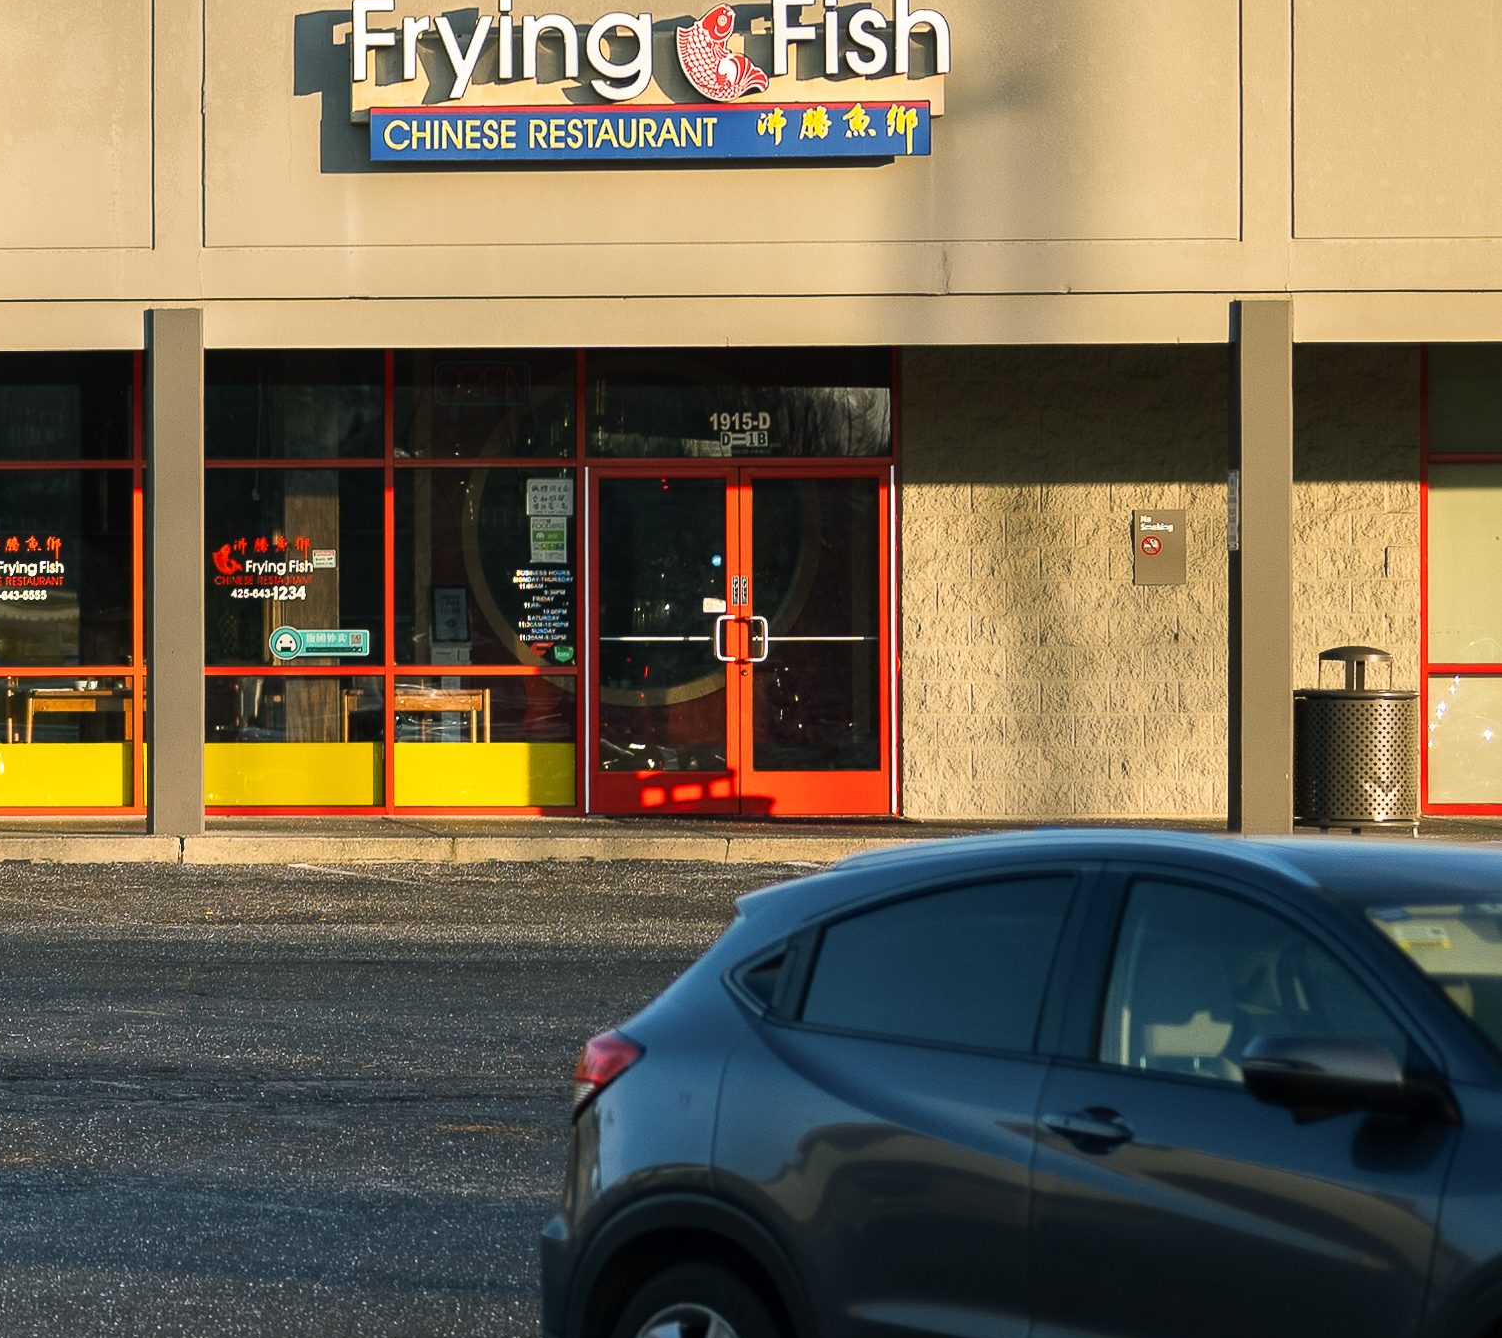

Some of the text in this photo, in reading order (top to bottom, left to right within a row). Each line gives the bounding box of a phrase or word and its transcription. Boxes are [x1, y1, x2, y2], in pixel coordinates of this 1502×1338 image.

[384, 116, 717, 152] CHINESE RESTAURANT
[710, 412, 771, 431] 1915-D
[39, 560, 65, 574] Fish
[245, 559, 314, 575] Frying Fish
[5, 576, 64, 586] RESTAURANT
[214, 575, 313, 585] CHINESE RESTAURANT
[230, 585, 307, 600] 425-643-1234
